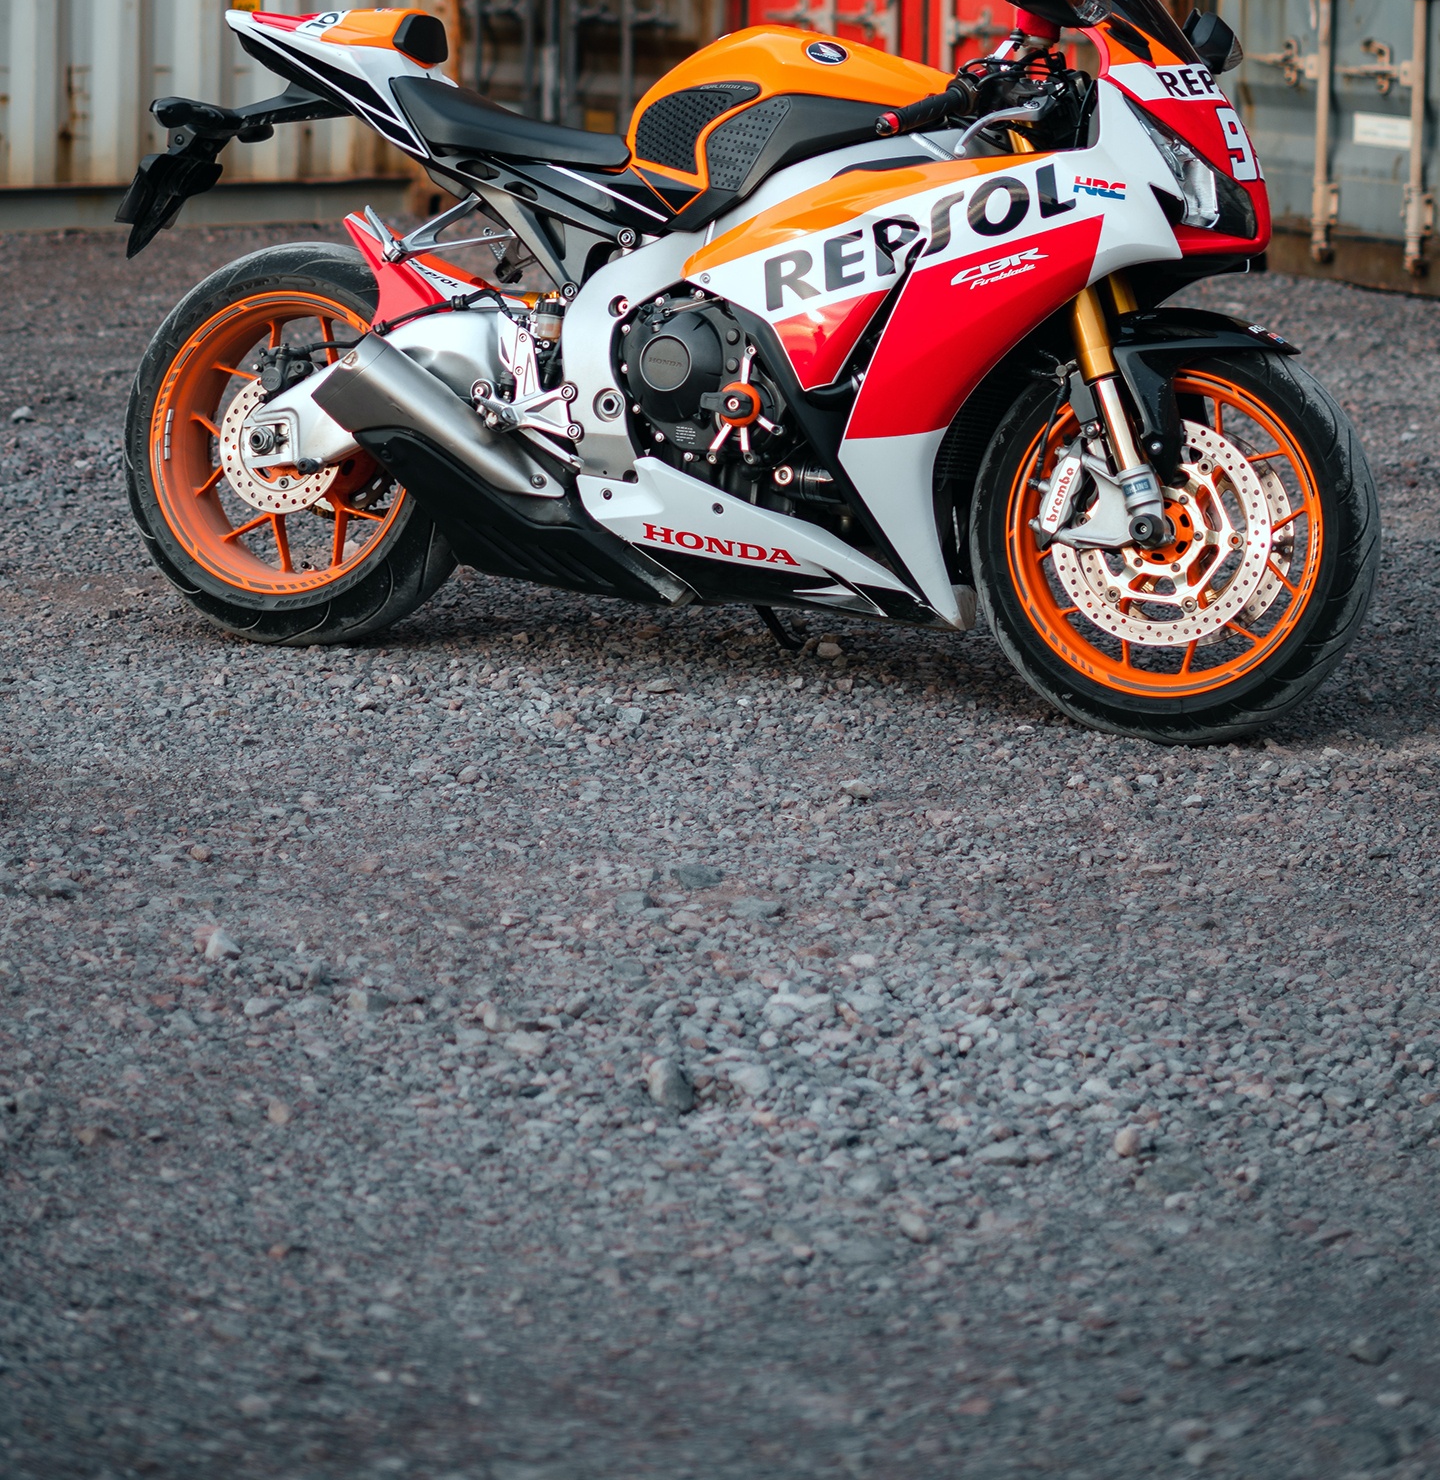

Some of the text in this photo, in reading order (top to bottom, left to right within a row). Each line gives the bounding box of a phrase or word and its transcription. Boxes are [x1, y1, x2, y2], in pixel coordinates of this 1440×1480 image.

[1156, 68, 1222, 98] REP
[1214, 106, 1264, 182] 9
[1073, 175, 1126, 200] HRC
[764, 163, 1077, 312] REPSOL
[950, 247, 1049, 286] CBR
[970, 262, 1036, 290] Fireblade
[648, 356, 683, 368] HONDA
[1046, 467, 1075, 523] brembo
[642, 522, 801, 566] HONDA
